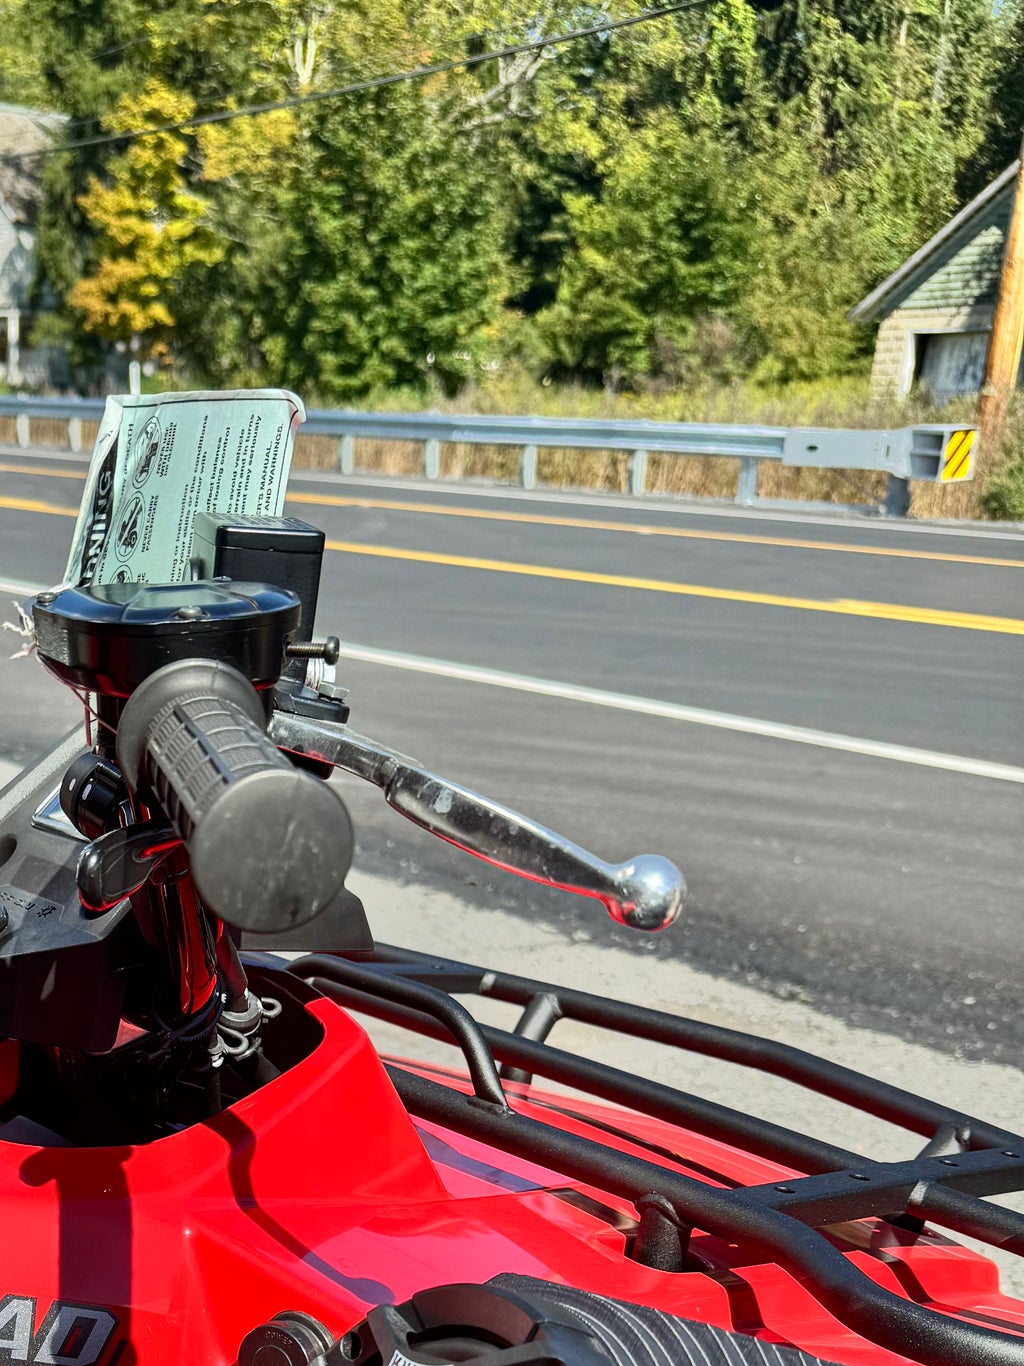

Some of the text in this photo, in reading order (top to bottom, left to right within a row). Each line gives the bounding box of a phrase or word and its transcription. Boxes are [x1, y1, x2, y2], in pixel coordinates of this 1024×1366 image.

[194, 415, 209, 473] conditions
[210, 436, 222, 480] balance
[220, 426, 231, 465] control
[229, 470, 238, 501] avoid
[234, 428, 245, 468] vehicle
[239, 458, 247, 479] and
[264, 488, 272, 511] AND
